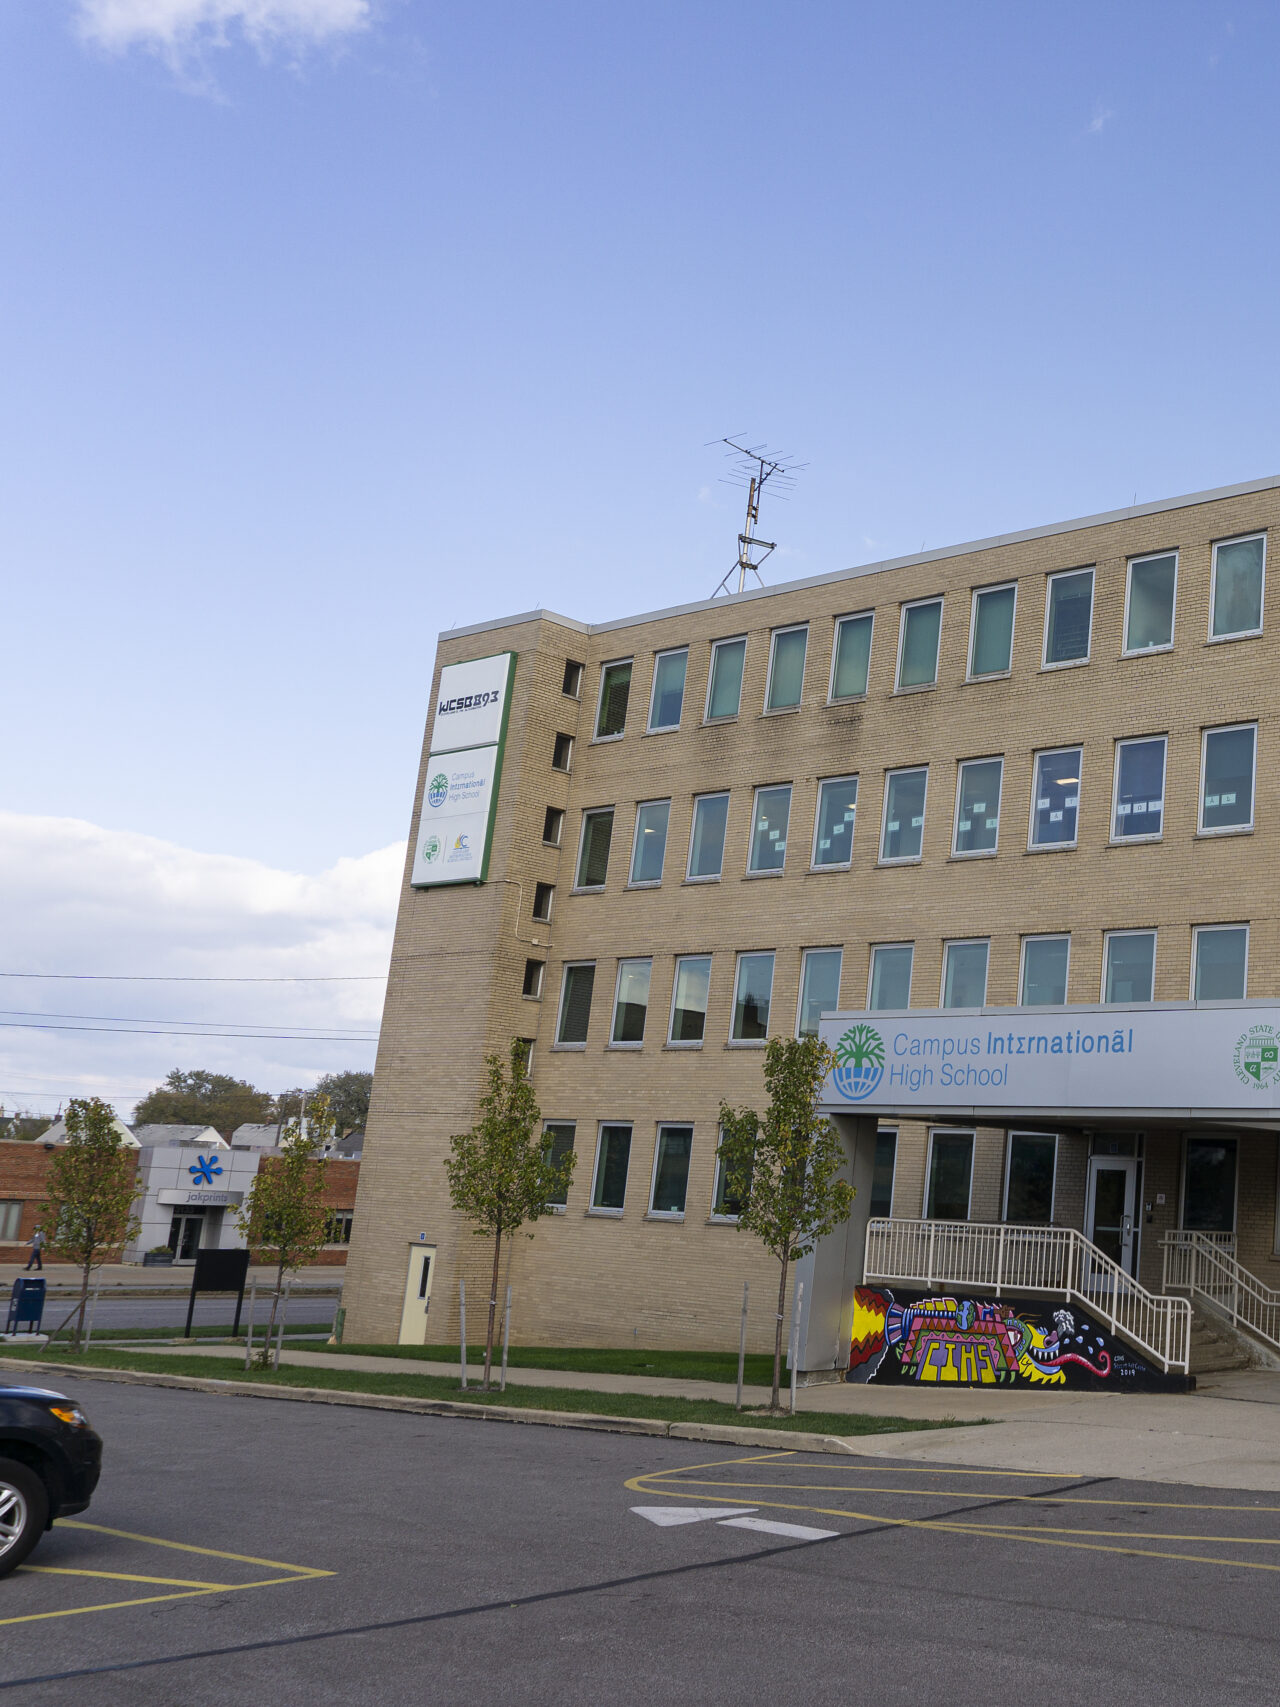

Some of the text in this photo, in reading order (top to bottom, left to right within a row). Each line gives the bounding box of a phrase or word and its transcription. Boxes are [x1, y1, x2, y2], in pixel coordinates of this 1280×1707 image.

[893, 1033, 981, 1060] Campus
[1233, 1034, 1250, 1085] CLEVELAND
[1249, 1024, 1274, 1035] STATE
[889, 1063, 1008, 1092] High School
[1252, 1081, 1269, 1090] 1964
[186, 1191, 228, 1204] jakprints
[920, 1342, 997, 1384] CIHS
[1120, 1369, 1136, 1377] 2019
